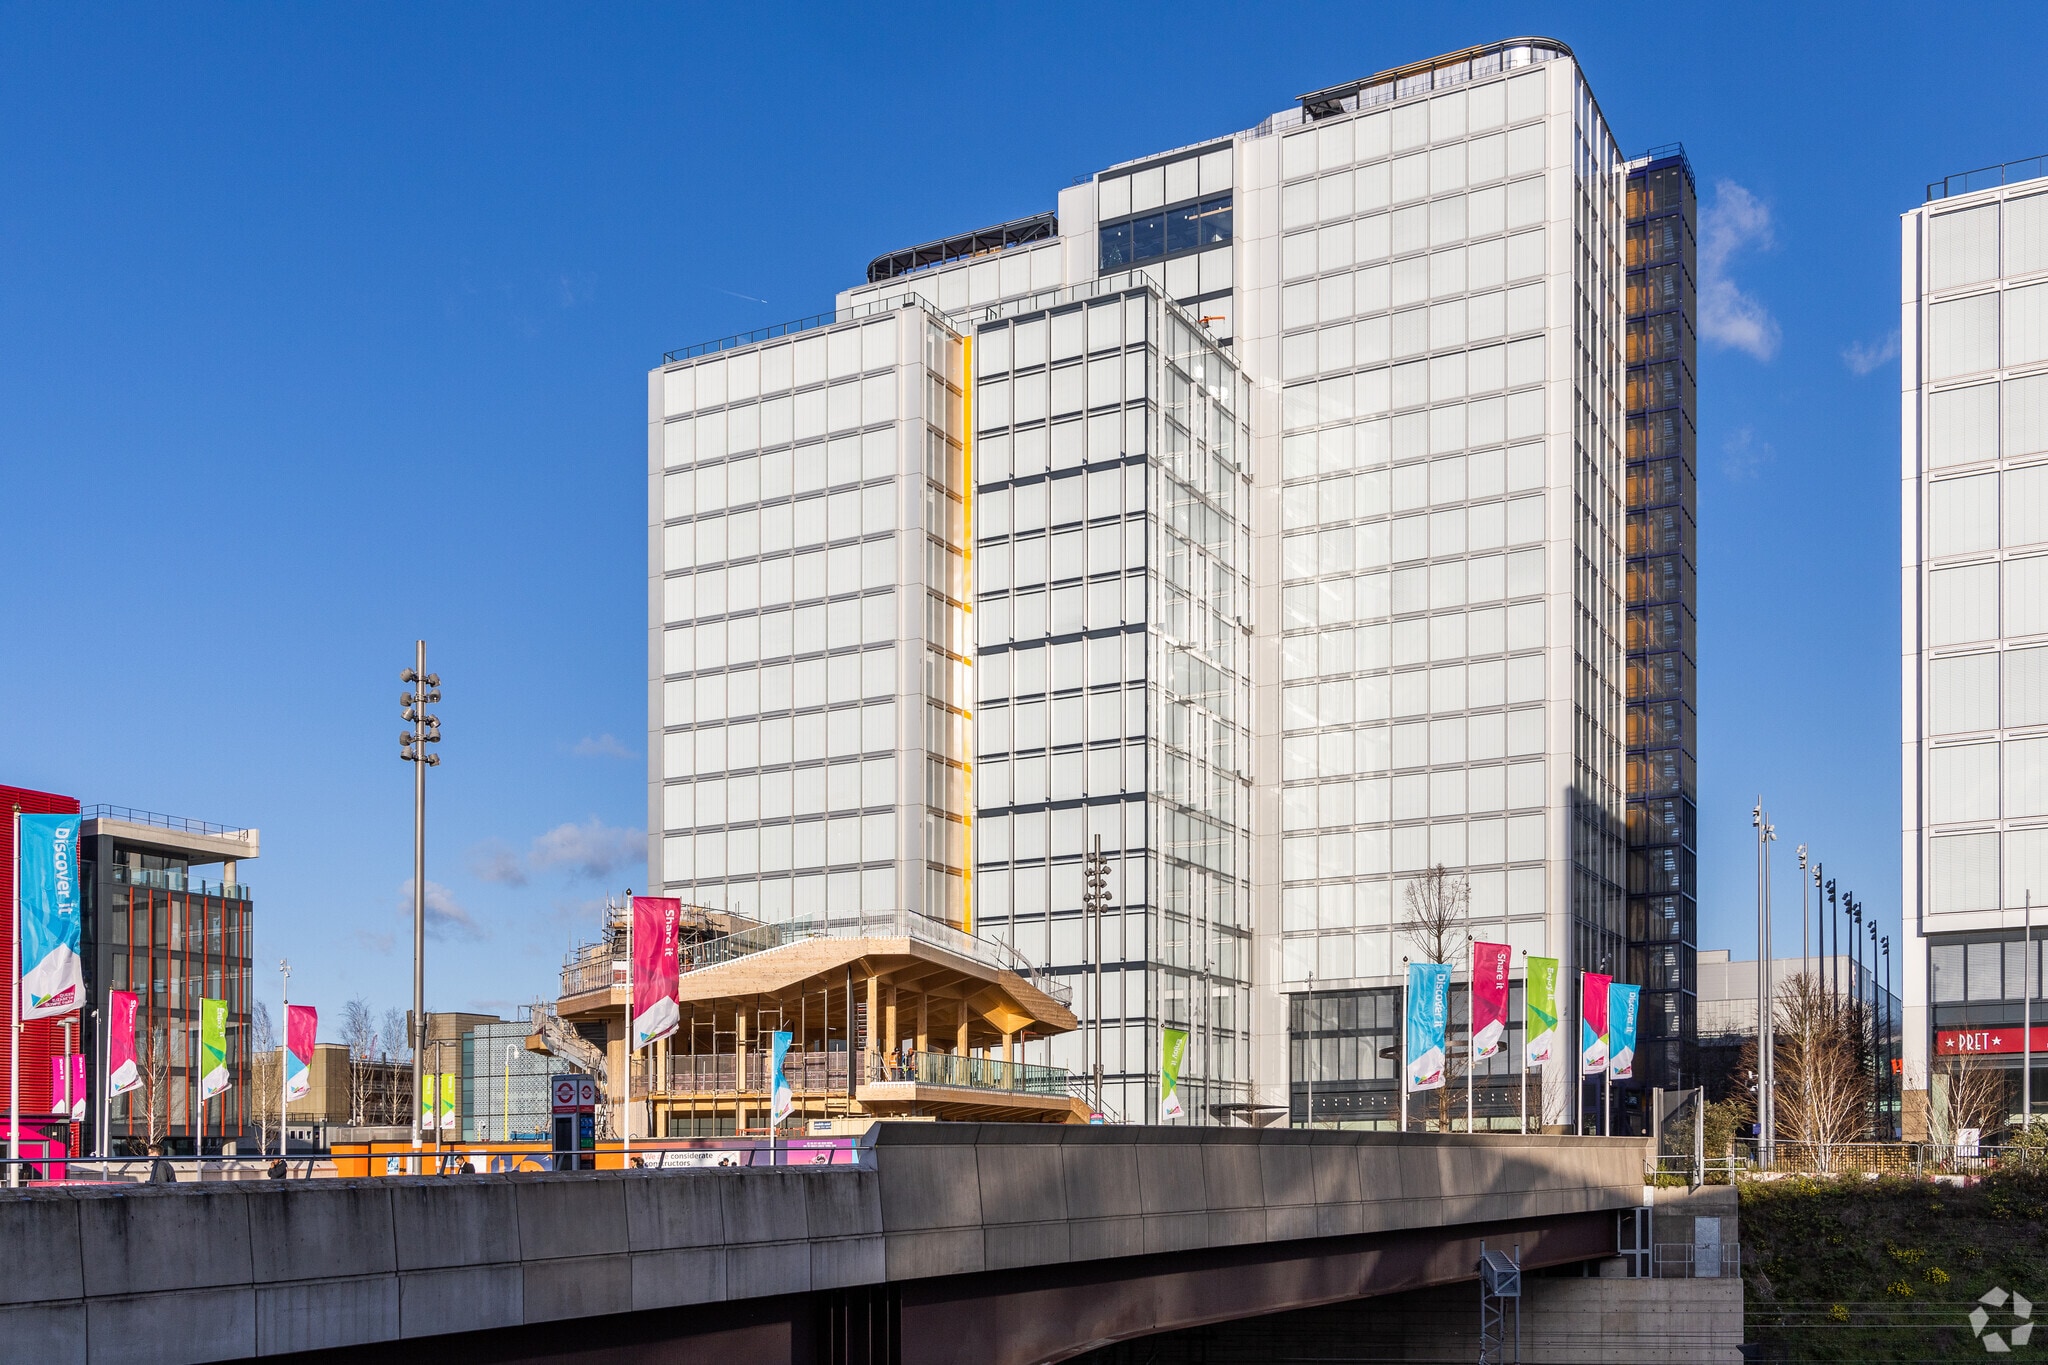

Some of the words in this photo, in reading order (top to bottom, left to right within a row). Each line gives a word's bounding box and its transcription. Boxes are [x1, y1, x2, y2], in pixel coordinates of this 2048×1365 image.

[53, 827, 71, 898] Discover
[58, 902, 74, 915] it
[664, 909, 675, 945] Share
[664, 947, 673, 957] it
[1496, 953, 1506, 980] Share
[1496, 982, 1504, 990] it
[1546, 967, 1554, 994] Enjoy
[1433, 973, 1446, 1016] Discover
[1626, 992, 1636, 1026] Discover
[1433, 1018, 1442, 1028] it
[1958, 1032, 1990, 1051] PRET
[670, 1152, 714, 1160] considerate
